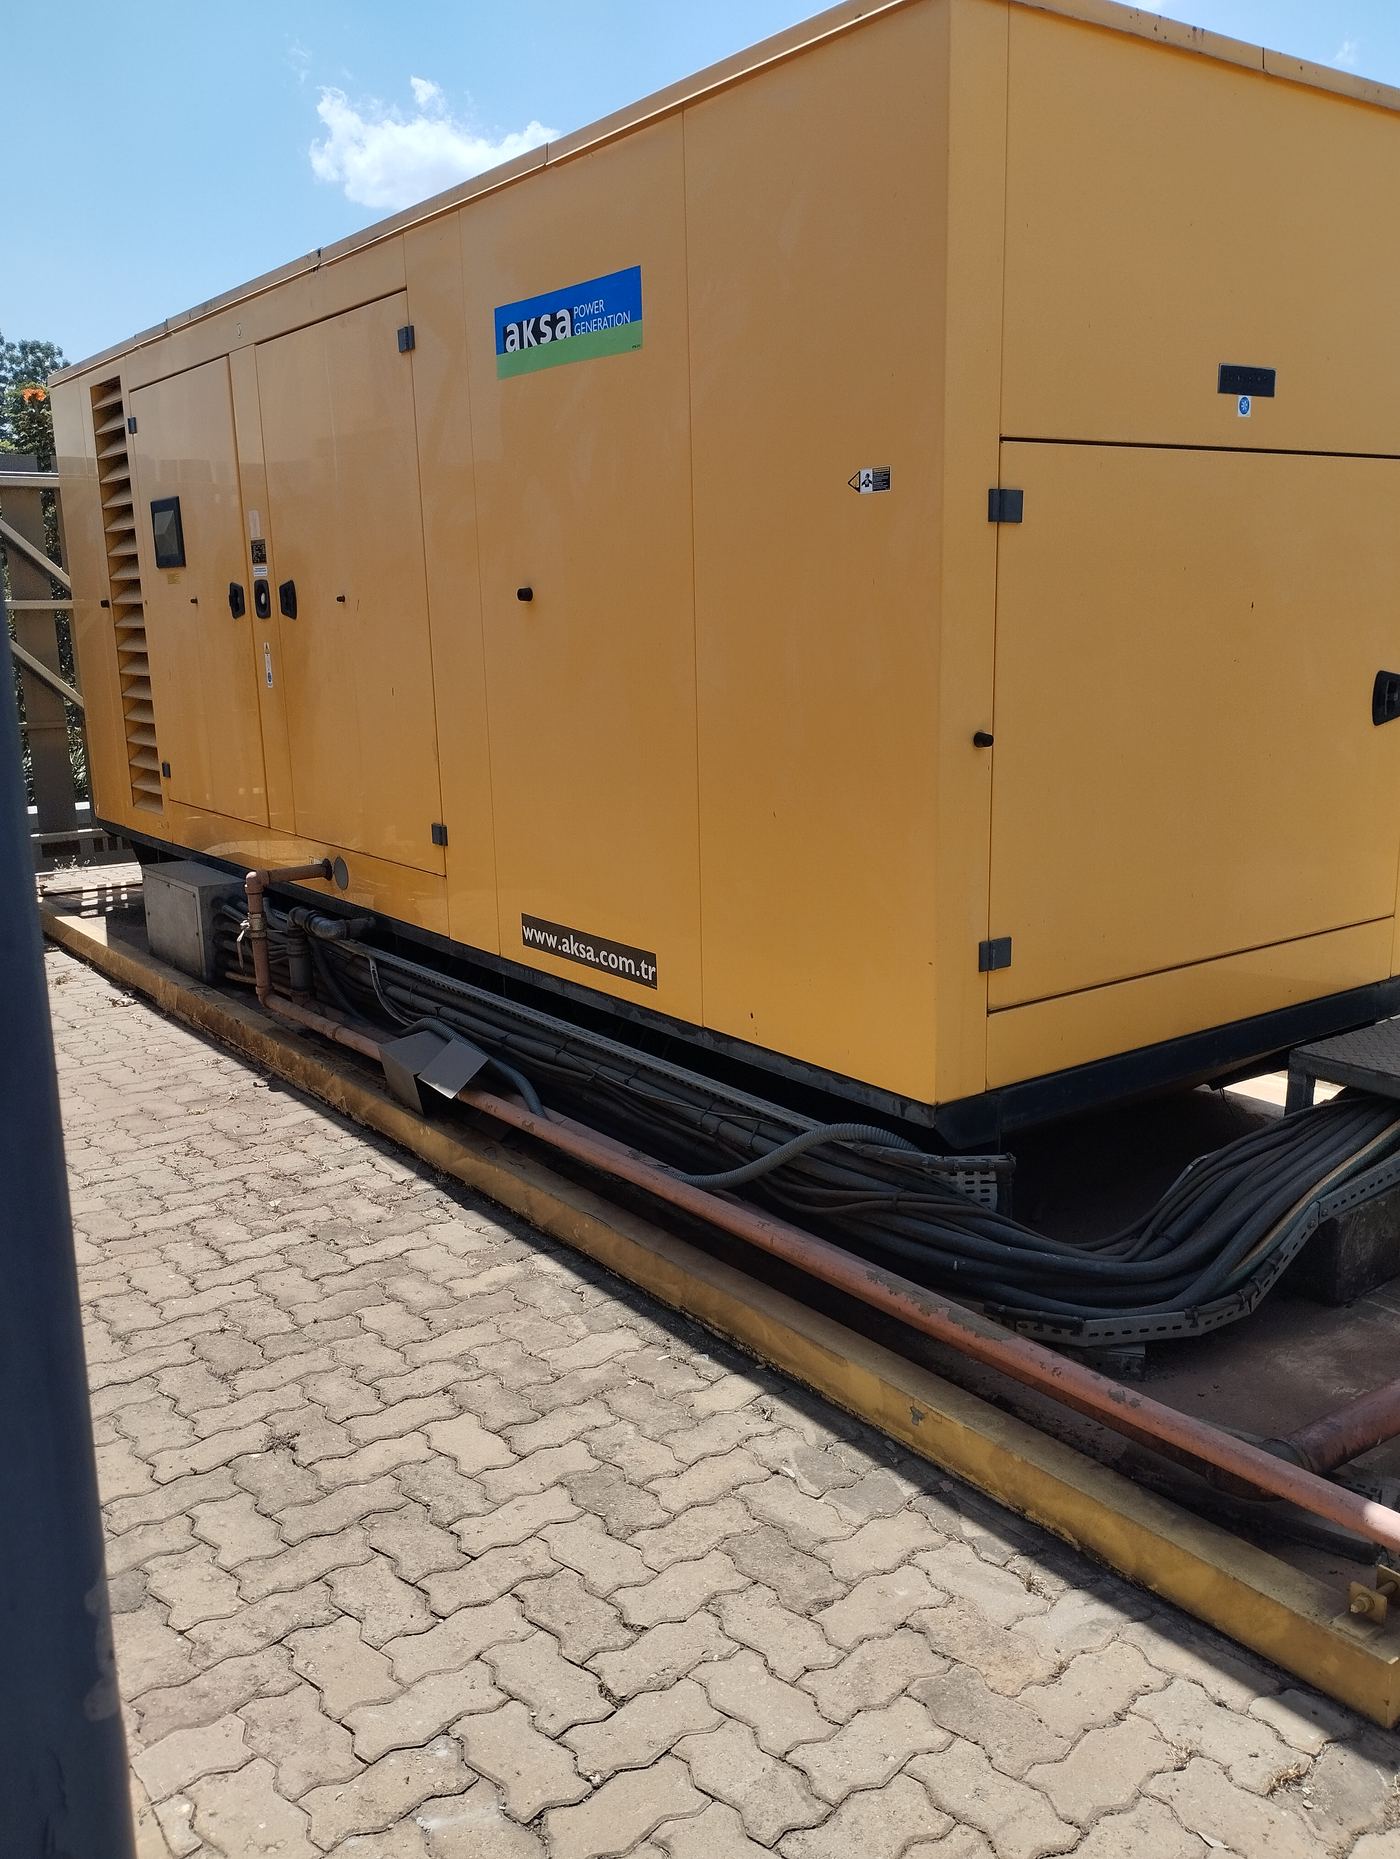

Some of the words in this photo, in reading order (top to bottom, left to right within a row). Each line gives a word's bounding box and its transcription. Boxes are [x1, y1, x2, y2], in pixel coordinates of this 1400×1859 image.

[573, 299, 605, 320] POWER
[574, 310, 631, 336] GENERATION
[505, 308, 572, 353] aksa
[522, 925, 656, 981] www.aksa.com.tr
